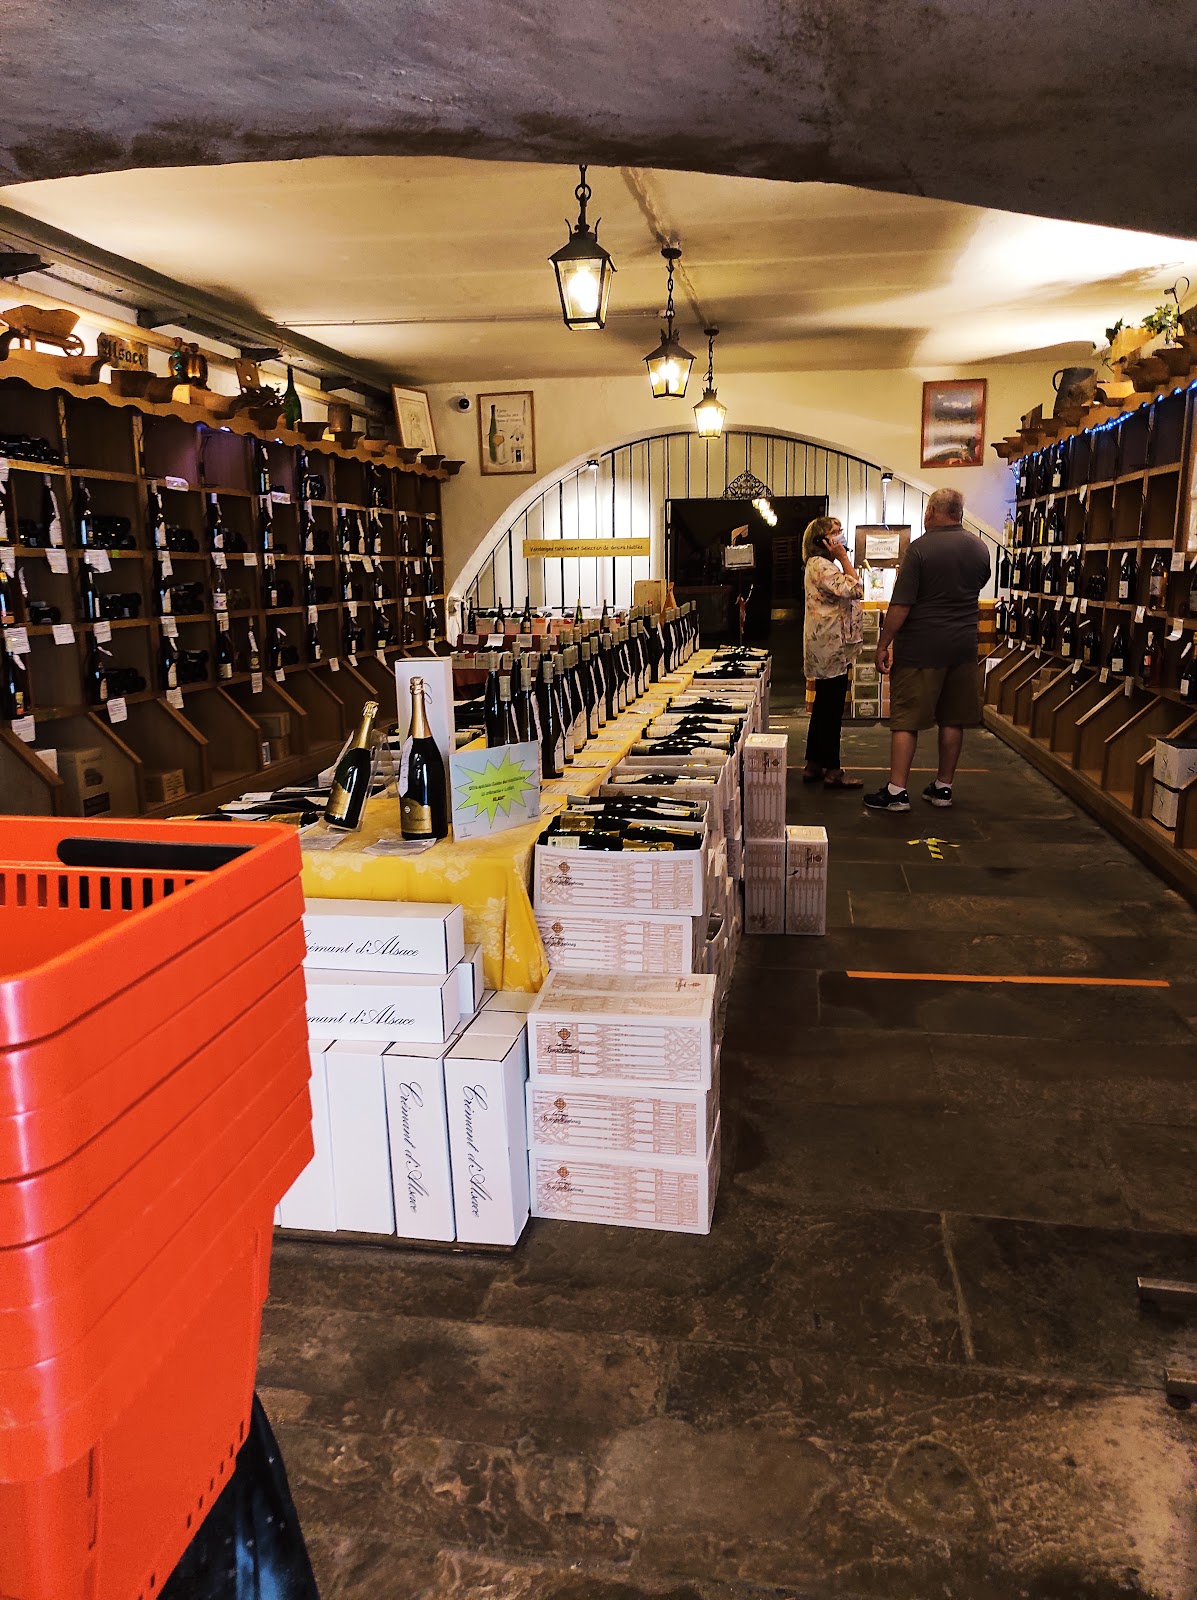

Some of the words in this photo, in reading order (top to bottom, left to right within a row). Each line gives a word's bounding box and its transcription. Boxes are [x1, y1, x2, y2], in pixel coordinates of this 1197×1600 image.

[100, 338, 144, 366] Alsace
[355, 934, 419, 957] d'Alsace
[349, 1003, 415, 1025] d'Alsace
[399, 1081, 424, 1150] Crémant
[462, 1084, 489, 1153] Crémant
[404, 1148, 430, 1214] d'Alsace
[467, 1152, 494, 1218] d'Alsace
